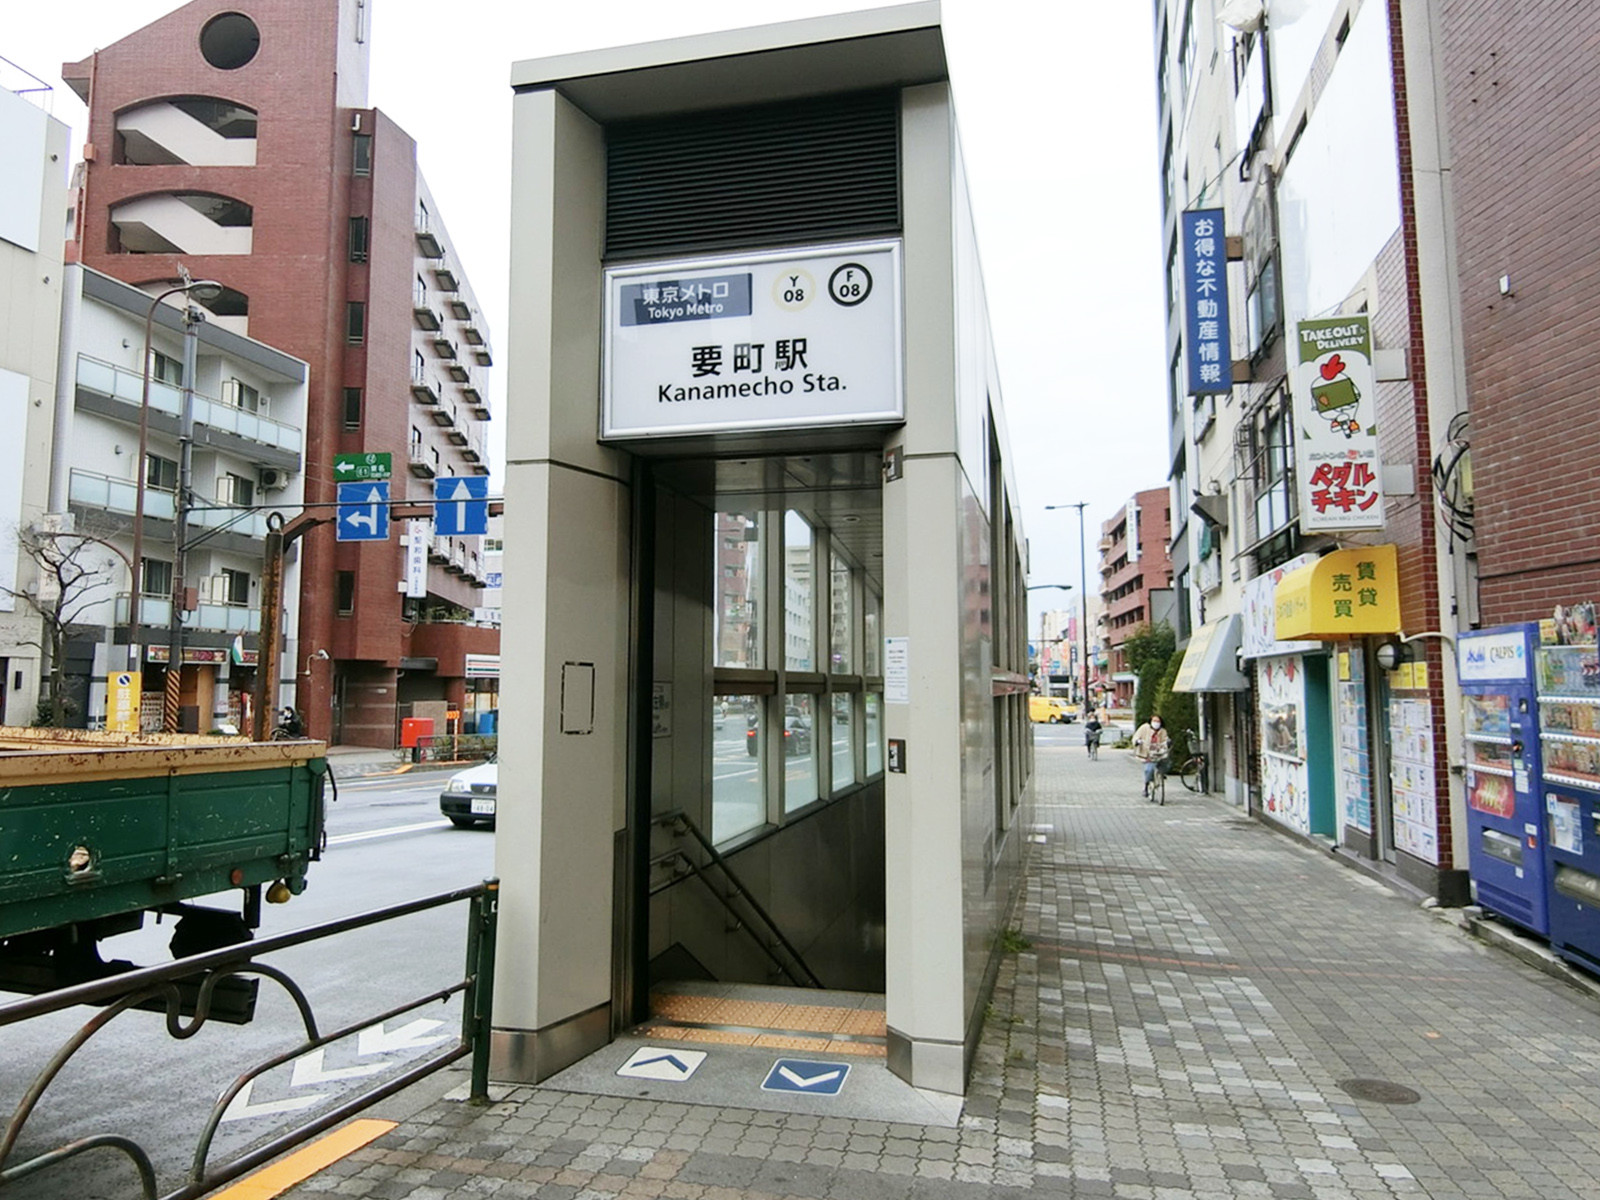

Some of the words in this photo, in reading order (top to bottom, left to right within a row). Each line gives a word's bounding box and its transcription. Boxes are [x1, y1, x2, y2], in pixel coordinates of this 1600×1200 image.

[789, 276, 799, 287] Y
[846, 271, 854, 282] F
[642, 281, 729, 305] 東京メトロ
[783, 289, 805, 302] 08
[839, 284, 861, 298] 08
[1194, 218, 1221, 384] お得な不動産情報
[648, 306, 683, 320] Tokyo
[686, 302, 724, 316] Metro
[691, 338, 808, 378] 要町駅
[658, 375, 793, 403] Kanamecho
[803, 373, 847, 393] Sta.
[1309, 462, 1376, 489] ペダル
[1311, 488, 1378, 514] チキン
[1332, 573, 1353, 618] 売買
[1357, 561, 1378, 607] 賃貸
[1490, 645, 1514, 663] CALPIS
